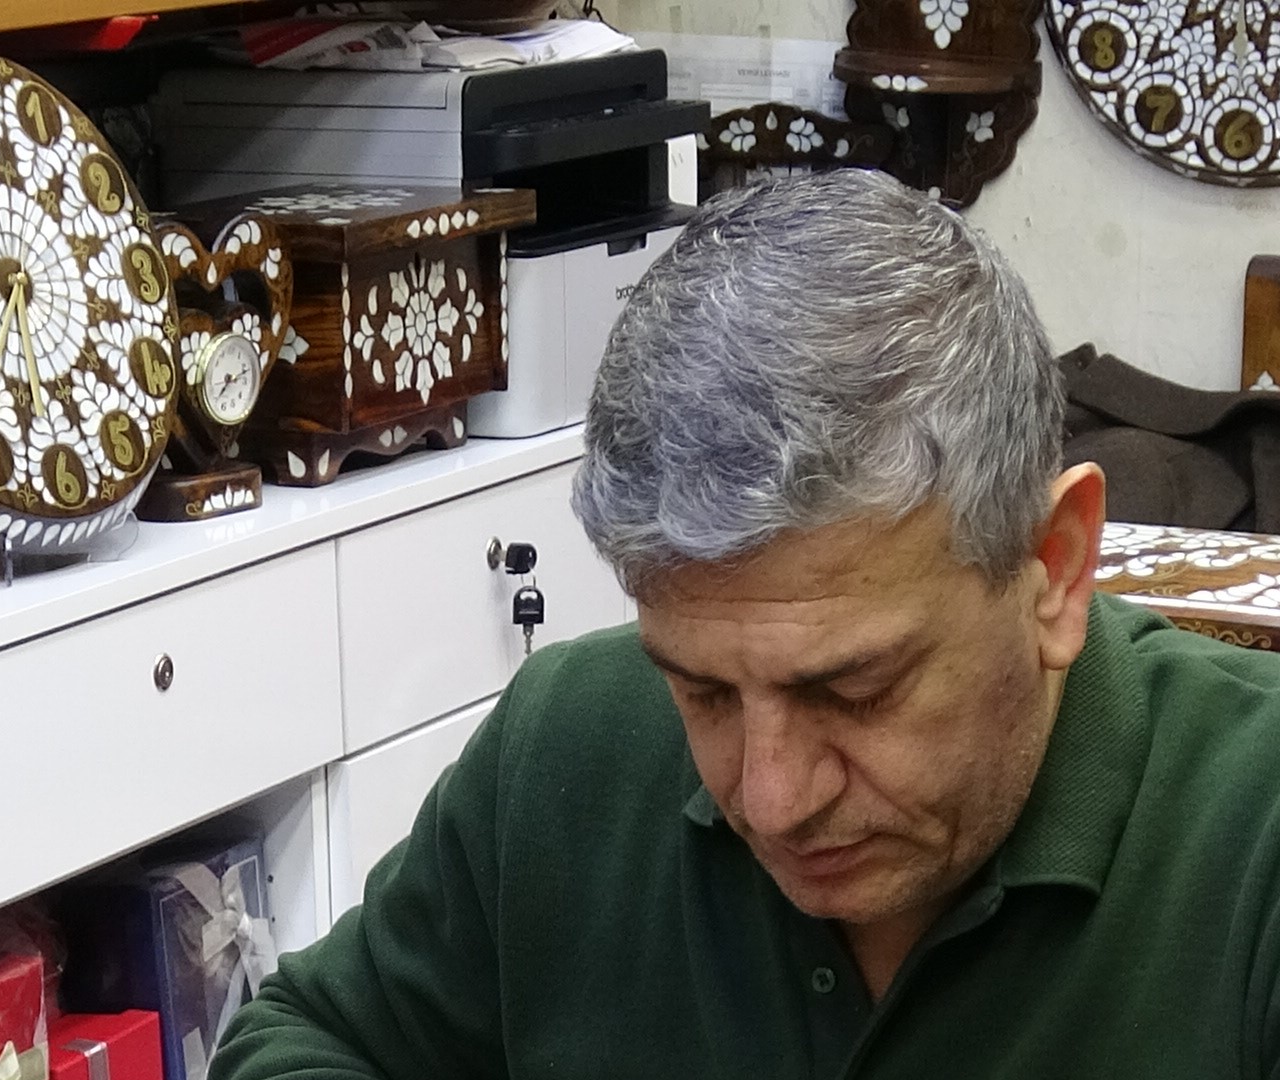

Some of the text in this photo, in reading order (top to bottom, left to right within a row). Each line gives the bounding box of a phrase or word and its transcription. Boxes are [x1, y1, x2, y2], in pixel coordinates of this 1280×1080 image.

[1094, 28, 1116, 69] 8
[25, 90, 48, 144] 1
[1145, 93, 1175, 132] 7
[1224, 115, 1252, 158] 6
[86, 161, 122, 215] 2
[130, 248, 162, 304] 3
[140, 341, 172, 397] 4
[108, 415, 134, 467] 5
[55, 451, 81, 502] 6
